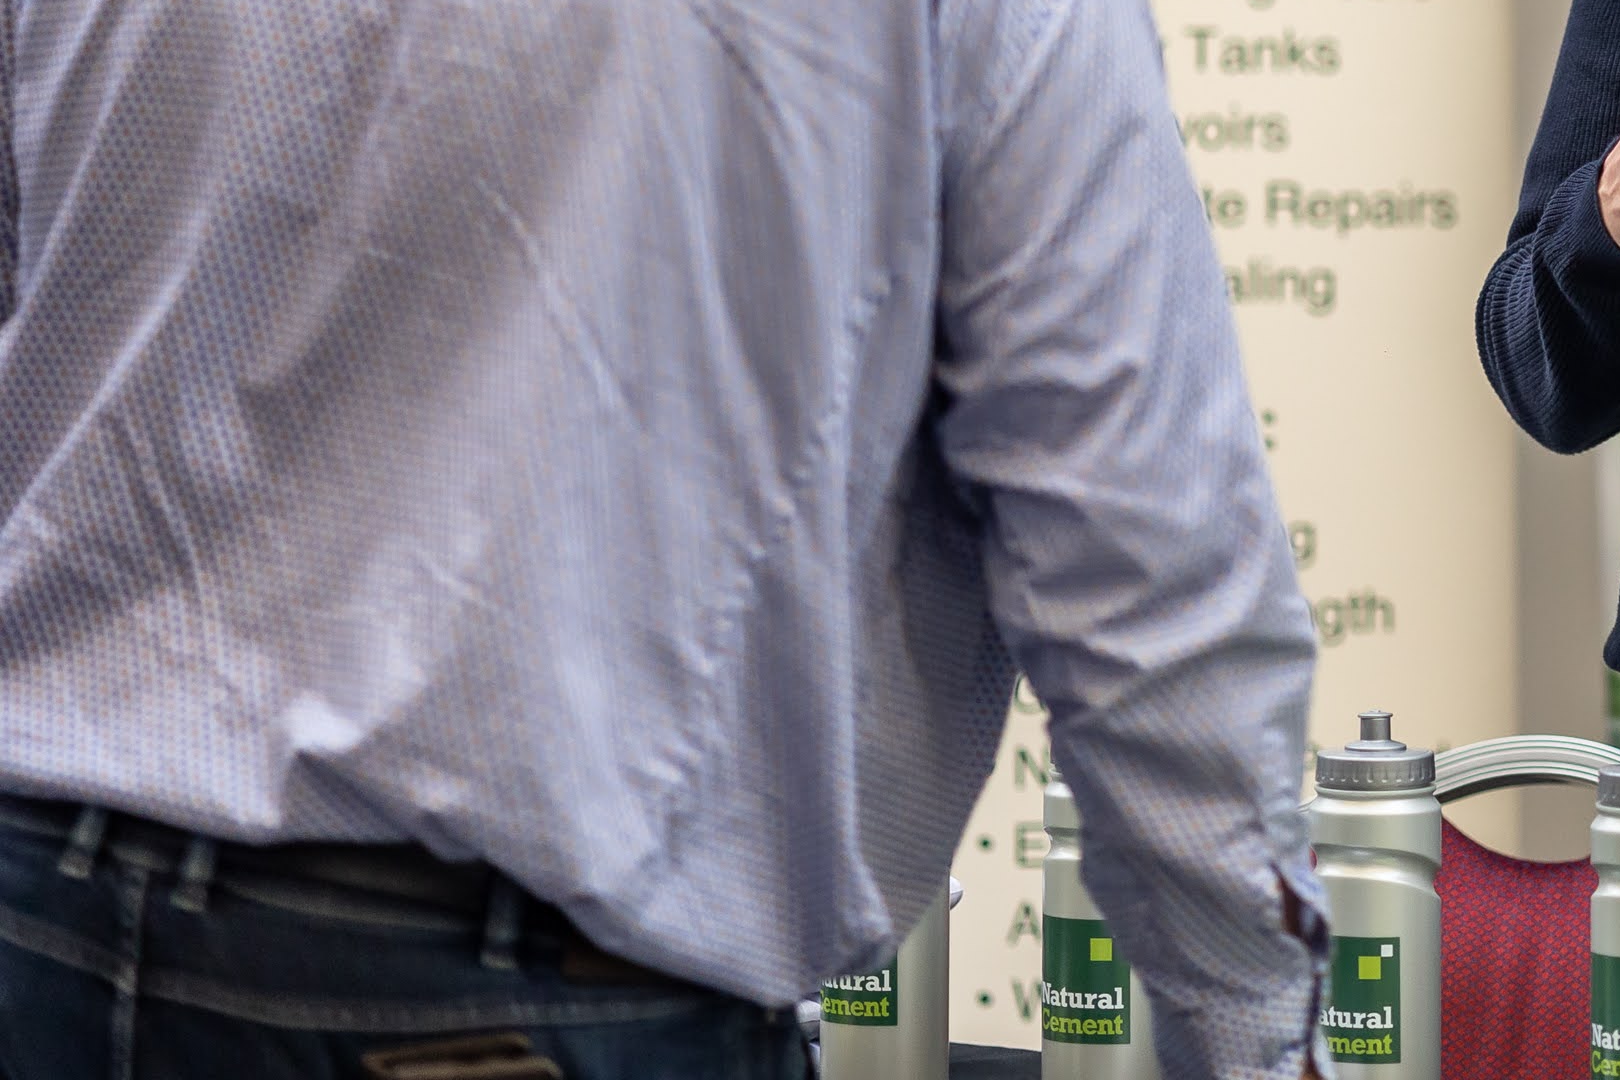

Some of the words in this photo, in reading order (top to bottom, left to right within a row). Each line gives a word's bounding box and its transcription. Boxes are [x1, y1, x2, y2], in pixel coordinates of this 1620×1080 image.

[1185, 24, 1342, 74] Tanks
[1264, 179, 1458, 239] Repairs
[821, 991, 890, 1017] ement
[1042, 981, 1124, 1009] Natural
[1043, 1008, 1124, 1035] Cement
[1320, 1006, 1393, 1029] atural
[1327, 1034, 1392, 1055] ment
